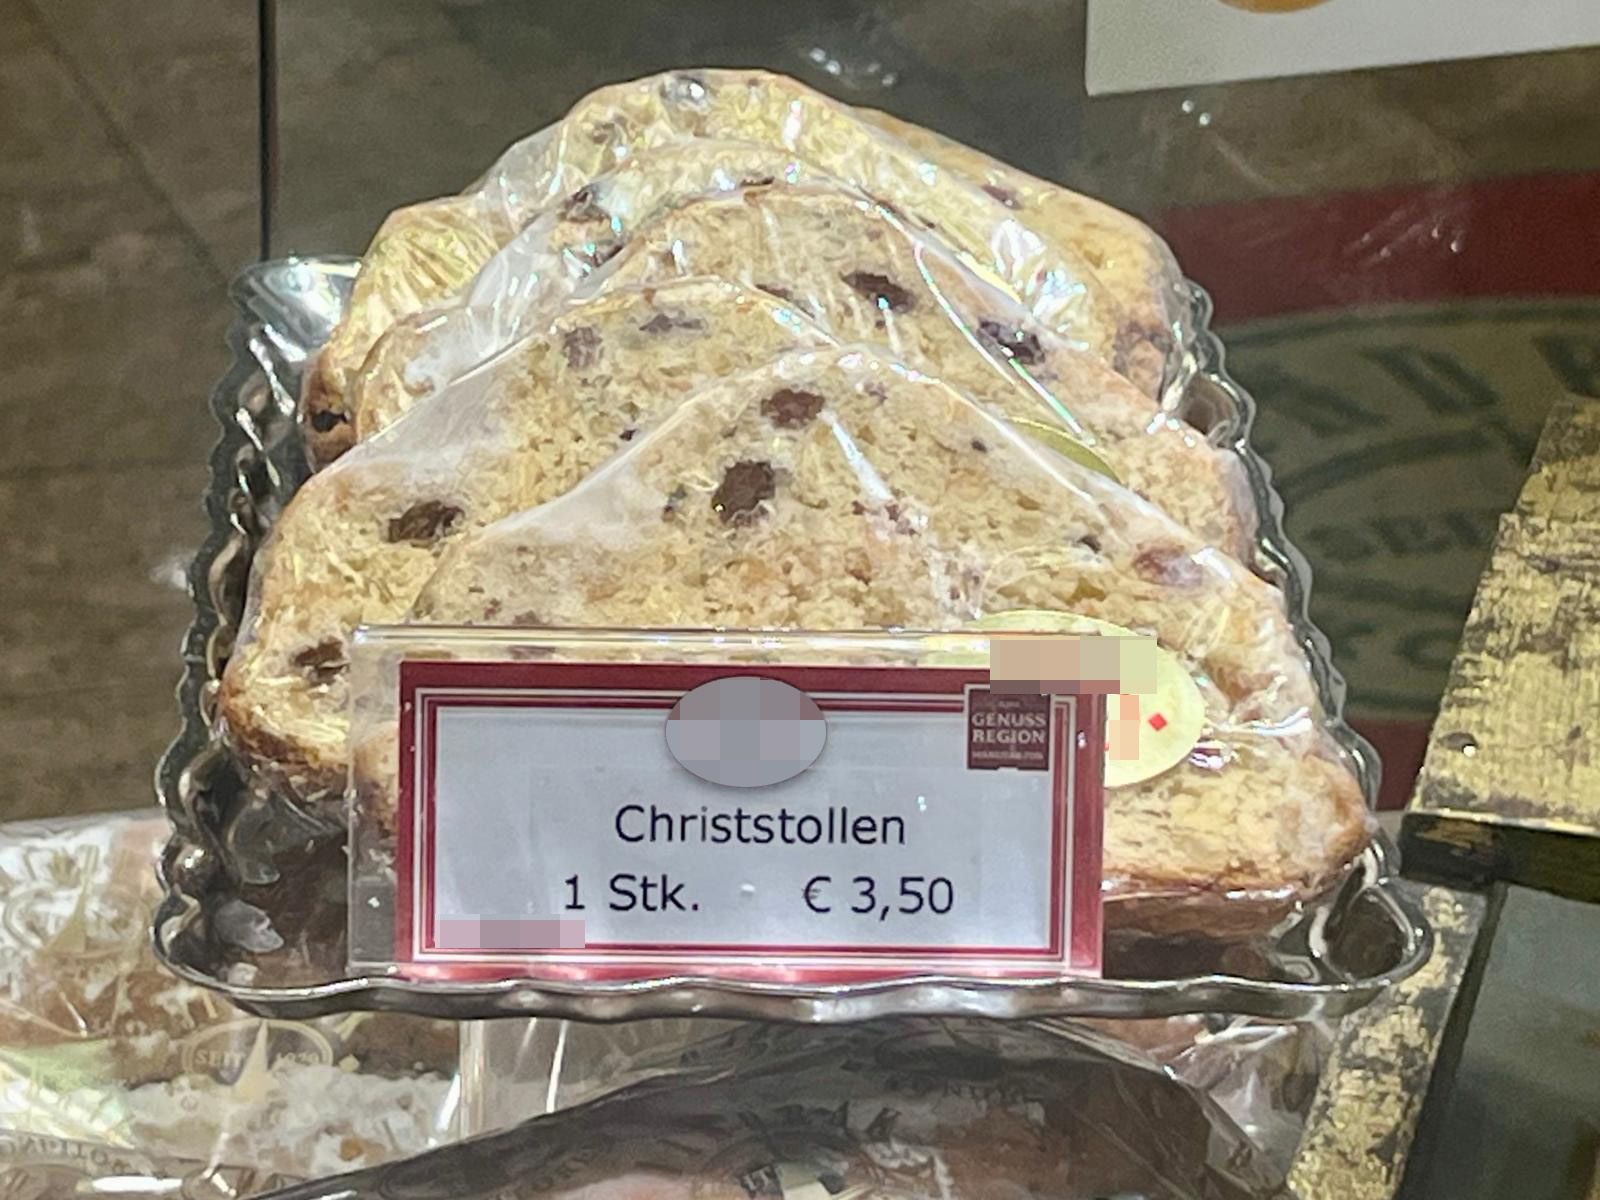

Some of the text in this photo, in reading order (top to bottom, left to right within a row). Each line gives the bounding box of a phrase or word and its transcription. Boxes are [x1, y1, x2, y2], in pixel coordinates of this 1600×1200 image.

[971, 712, 1047, 728] GENUSS
[971, 729, 1047, 744] REGION
[615, 803, 906, 846] Christstollen
[564, 873, 955, 922] 1 Stk. € 3,50
